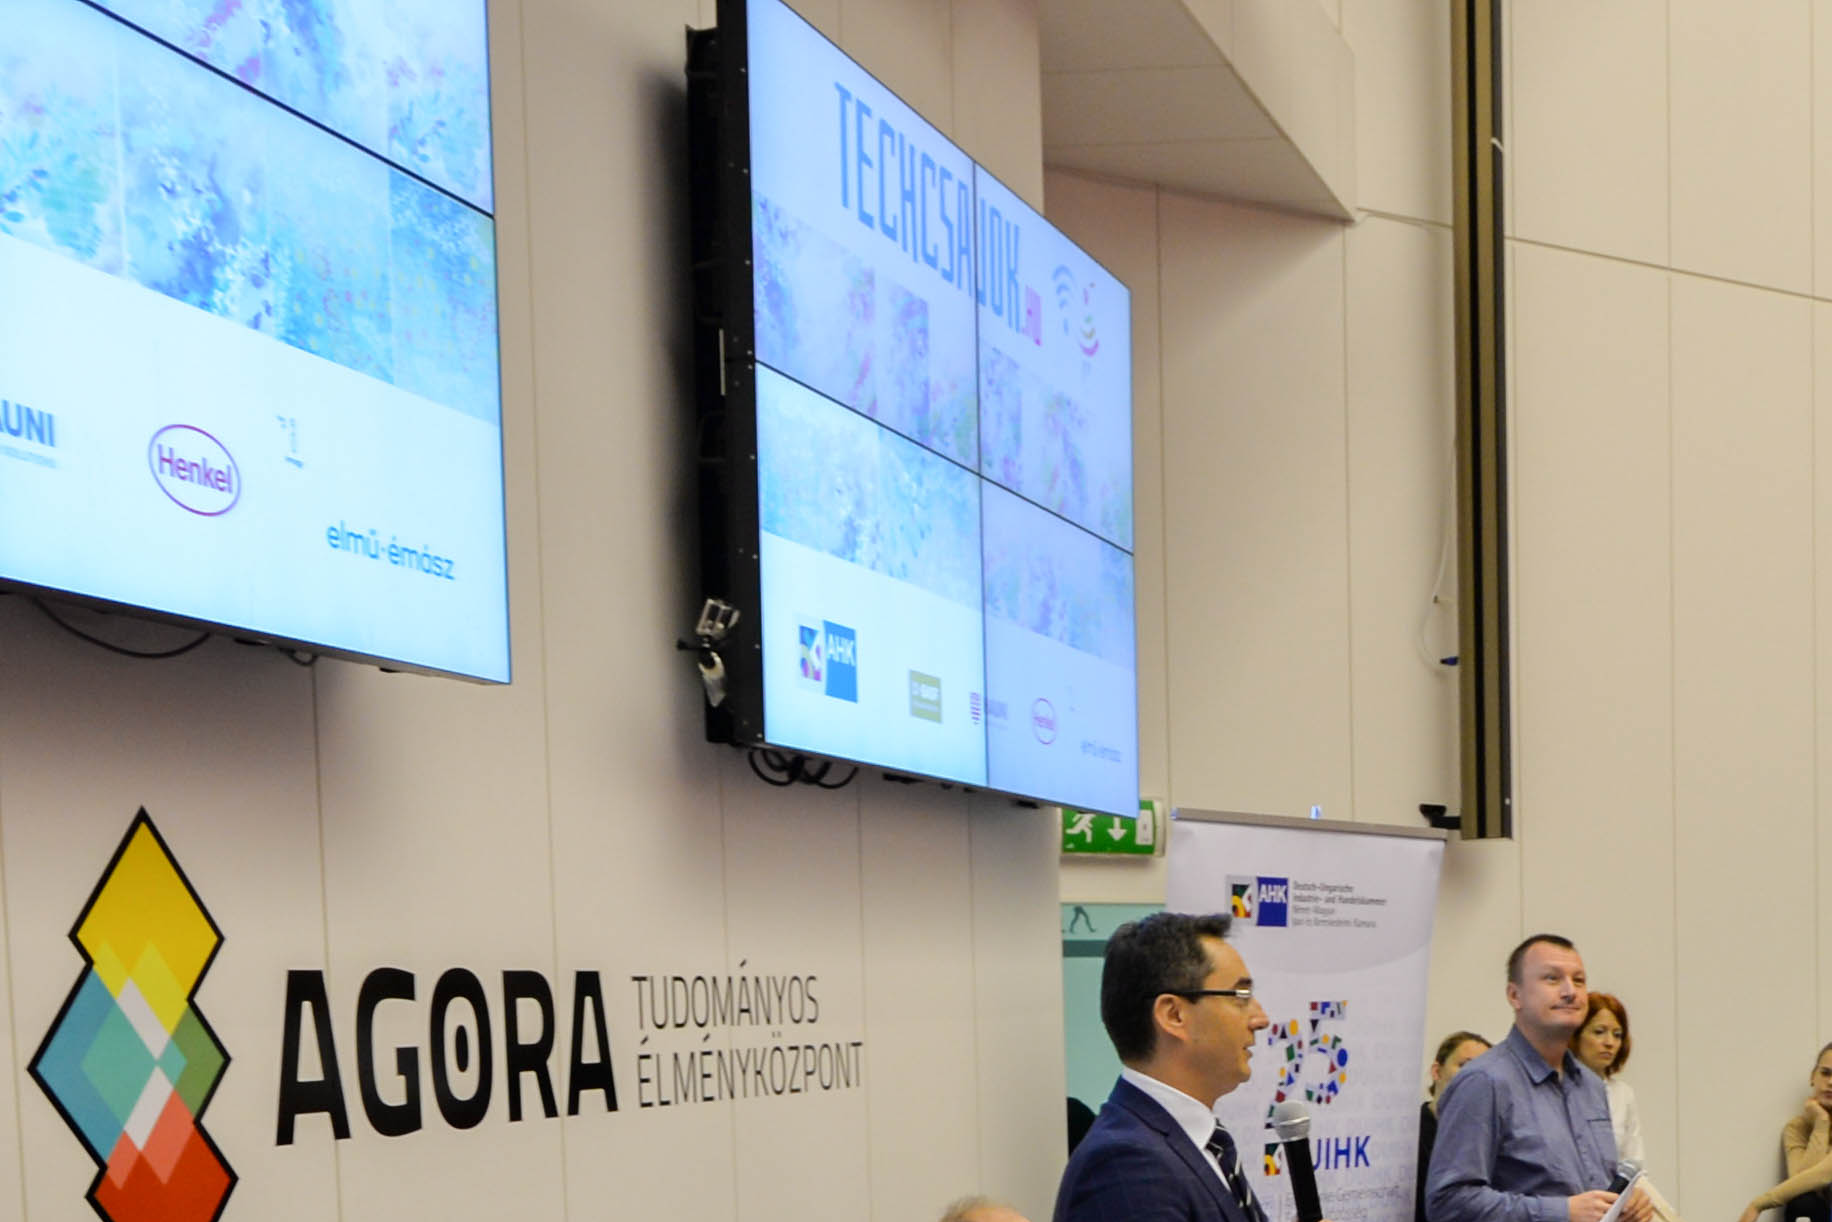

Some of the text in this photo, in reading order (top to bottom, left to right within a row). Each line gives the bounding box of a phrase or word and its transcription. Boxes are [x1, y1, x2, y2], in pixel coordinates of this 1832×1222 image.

[0, 398, 56, 447] UNI
[157, 443, 233, 494] Henkel
[826, 633, 856, 666] AHK
[1258, 884, 1288, 903] AHK
[631, 959, 820, 1029] TUDOMÁNYOS
[274, 966, 620, 1147] AGORA
[637, 1031, 864, 1109] ÉLMÉNYKÖZPONT
